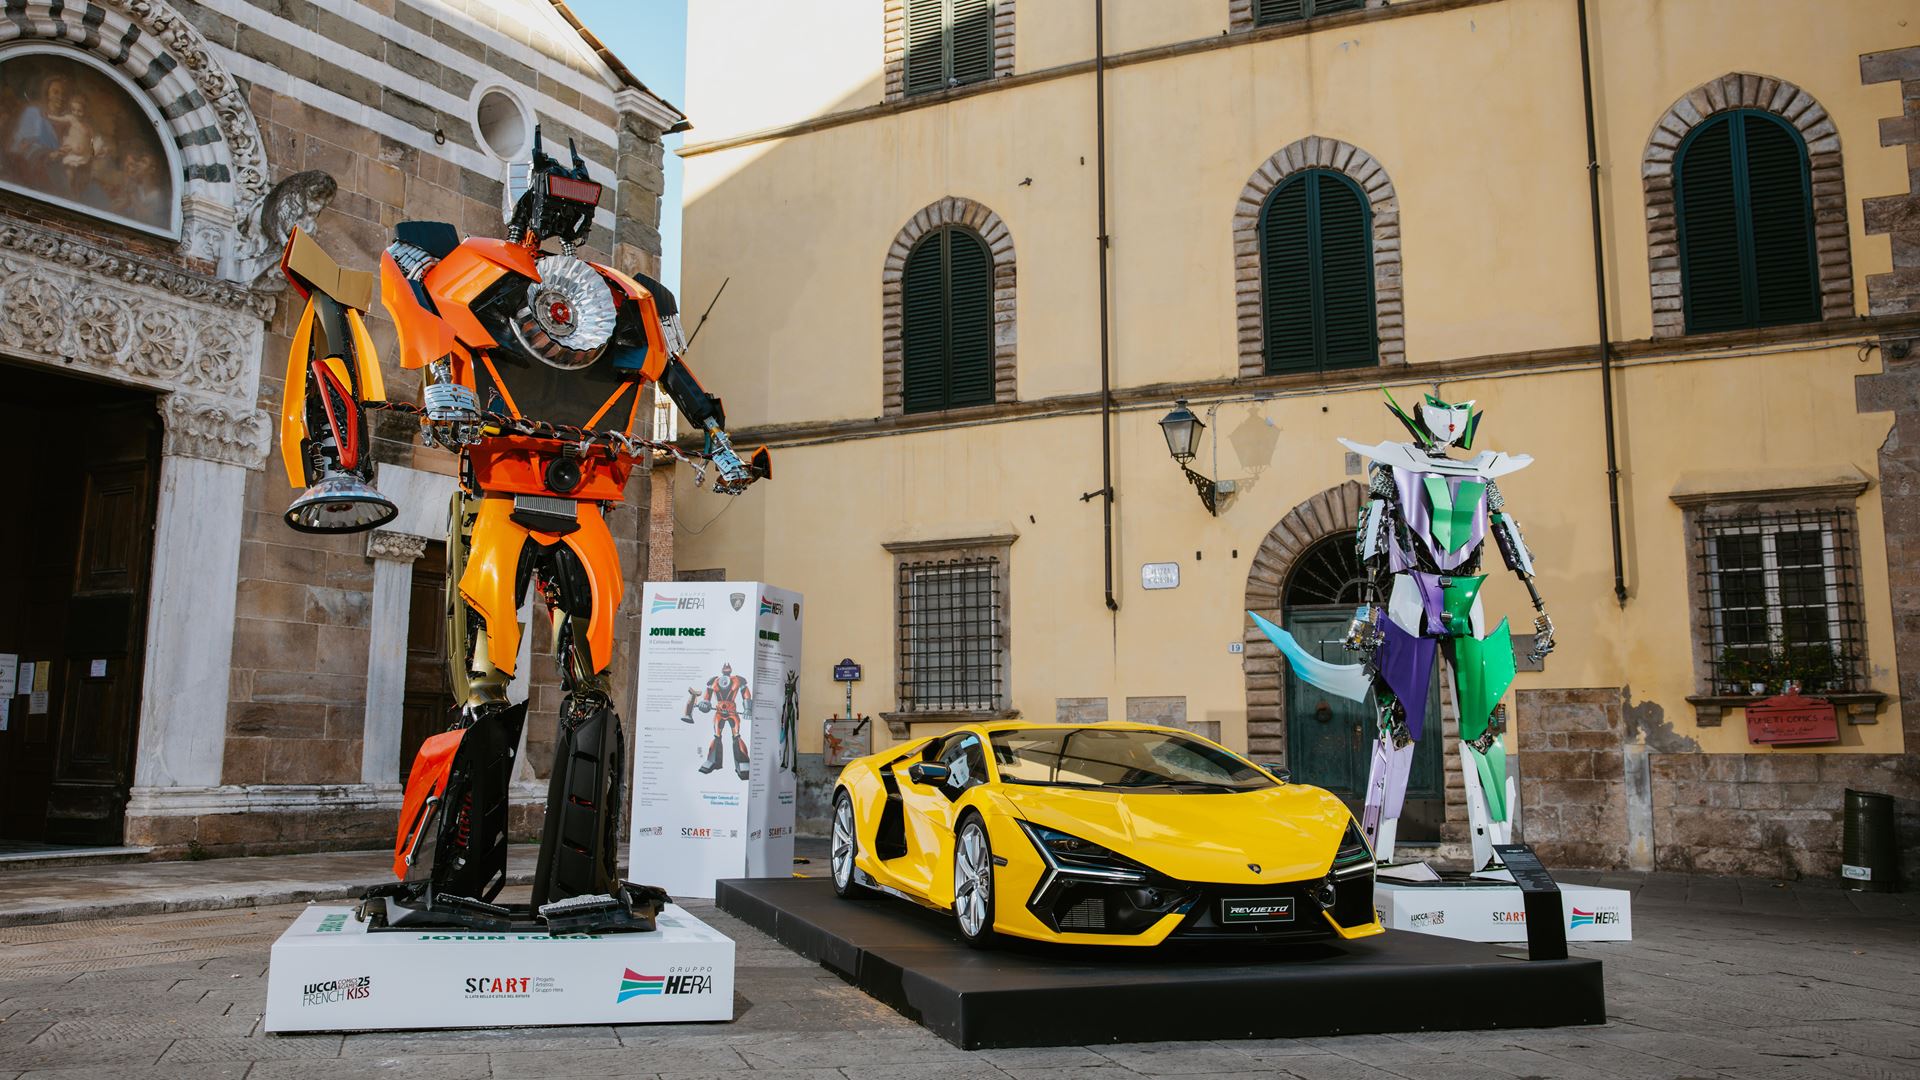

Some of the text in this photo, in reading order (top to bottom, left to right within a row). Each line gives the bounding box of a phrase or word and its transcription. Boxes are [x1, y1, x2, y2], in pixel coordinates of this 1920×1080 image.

[677, 598, 705, 609] HERA
[649, 628, 706, 636] JOTUN FORGE
[1231, 644, 1240, 652] 19
[681, 828, 711, 837] SCART
[1230, 905, 1289, 913] REVUELTO
[1410, 913, 1428, 921] LUCCA
[1493, 912, 1526, 922] SCART
[1594, 912, 1620, 924] HERA
[304, 980, 337, 994] LUCCA
[358, 976, 370, 987] 25
[465, 977, 531, 993] SCART
[664, 975, 712, 994] HERA
[302, 986, 370, 1007] FRENCH KISS
